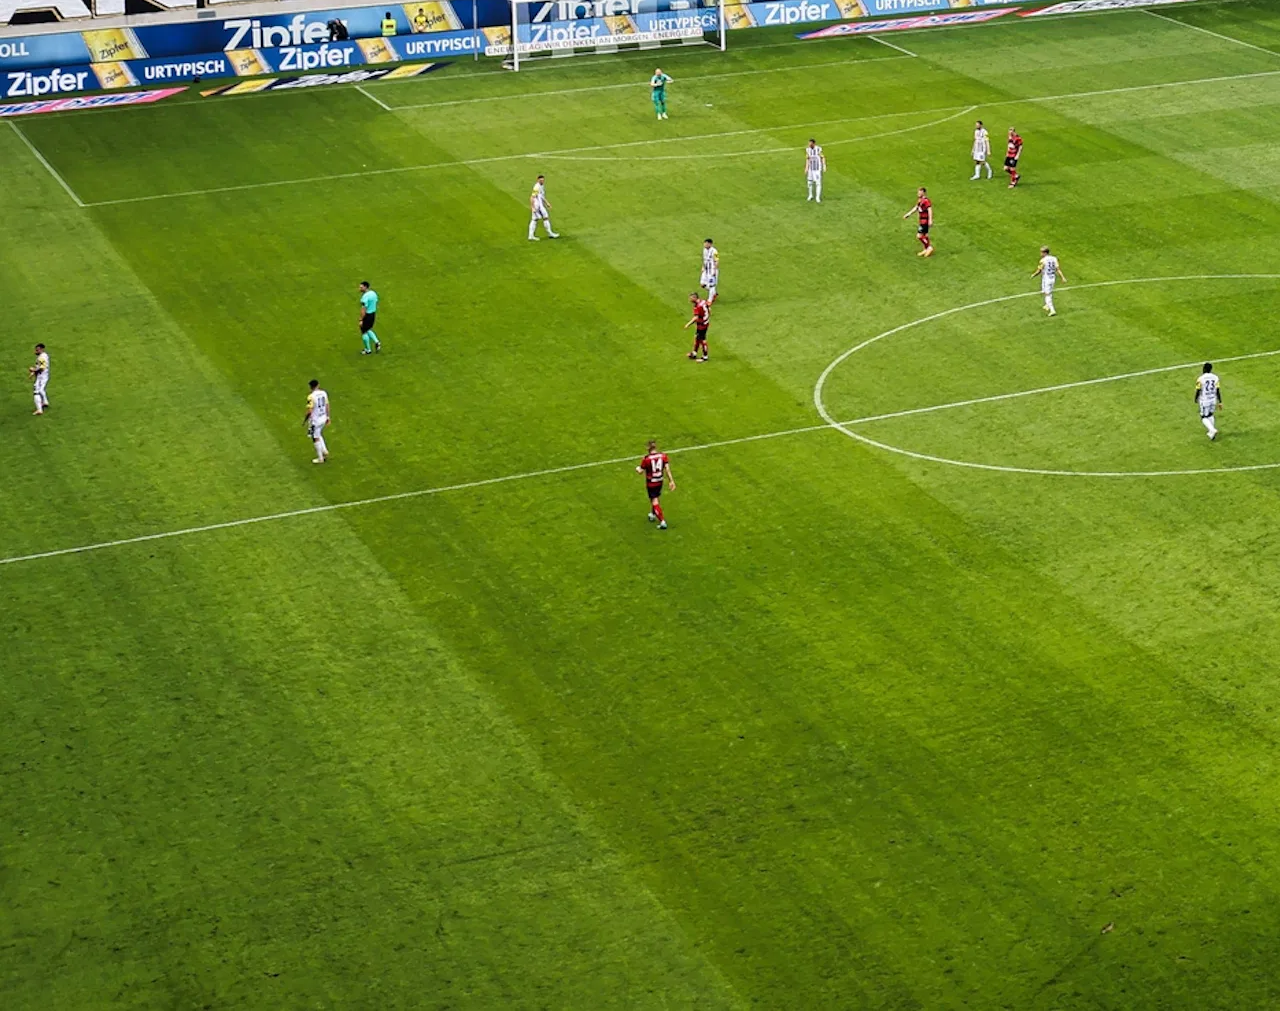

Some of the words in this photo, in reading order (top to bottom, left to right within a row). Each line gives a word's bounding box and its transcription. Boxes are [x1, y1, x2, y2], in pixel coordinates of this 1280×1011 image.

[765, 0, 830, 24] Zipfer
[279, 44, 354, 71] Zipfer
[406, 36, 480, 56] URTYPISCH
[7, 68, 88, 96] Zipfer
[145, 60, 225, 80] URTYPISCH
